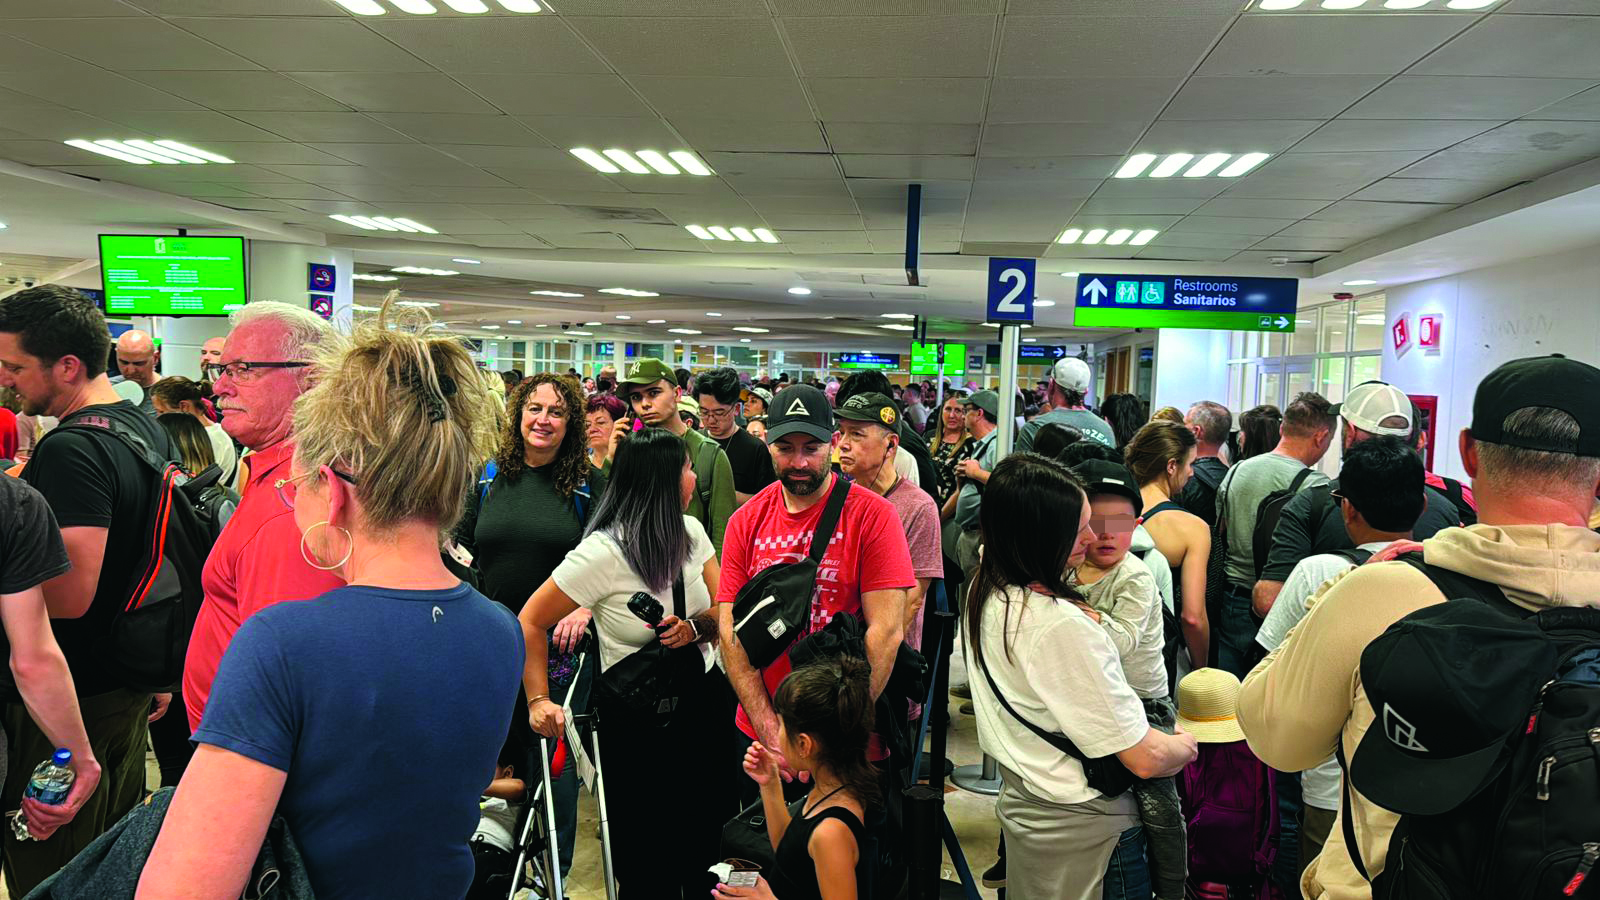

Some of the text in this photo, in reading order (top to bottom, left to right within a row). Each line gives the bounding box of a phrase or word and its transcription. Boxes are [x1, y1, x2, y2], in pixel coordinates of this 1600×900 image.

[997, 268, 1026, 312] 2
[1174, 279, 1238, 292] Restrooms
[1173, 293, 1237, 306] Sanitarios
